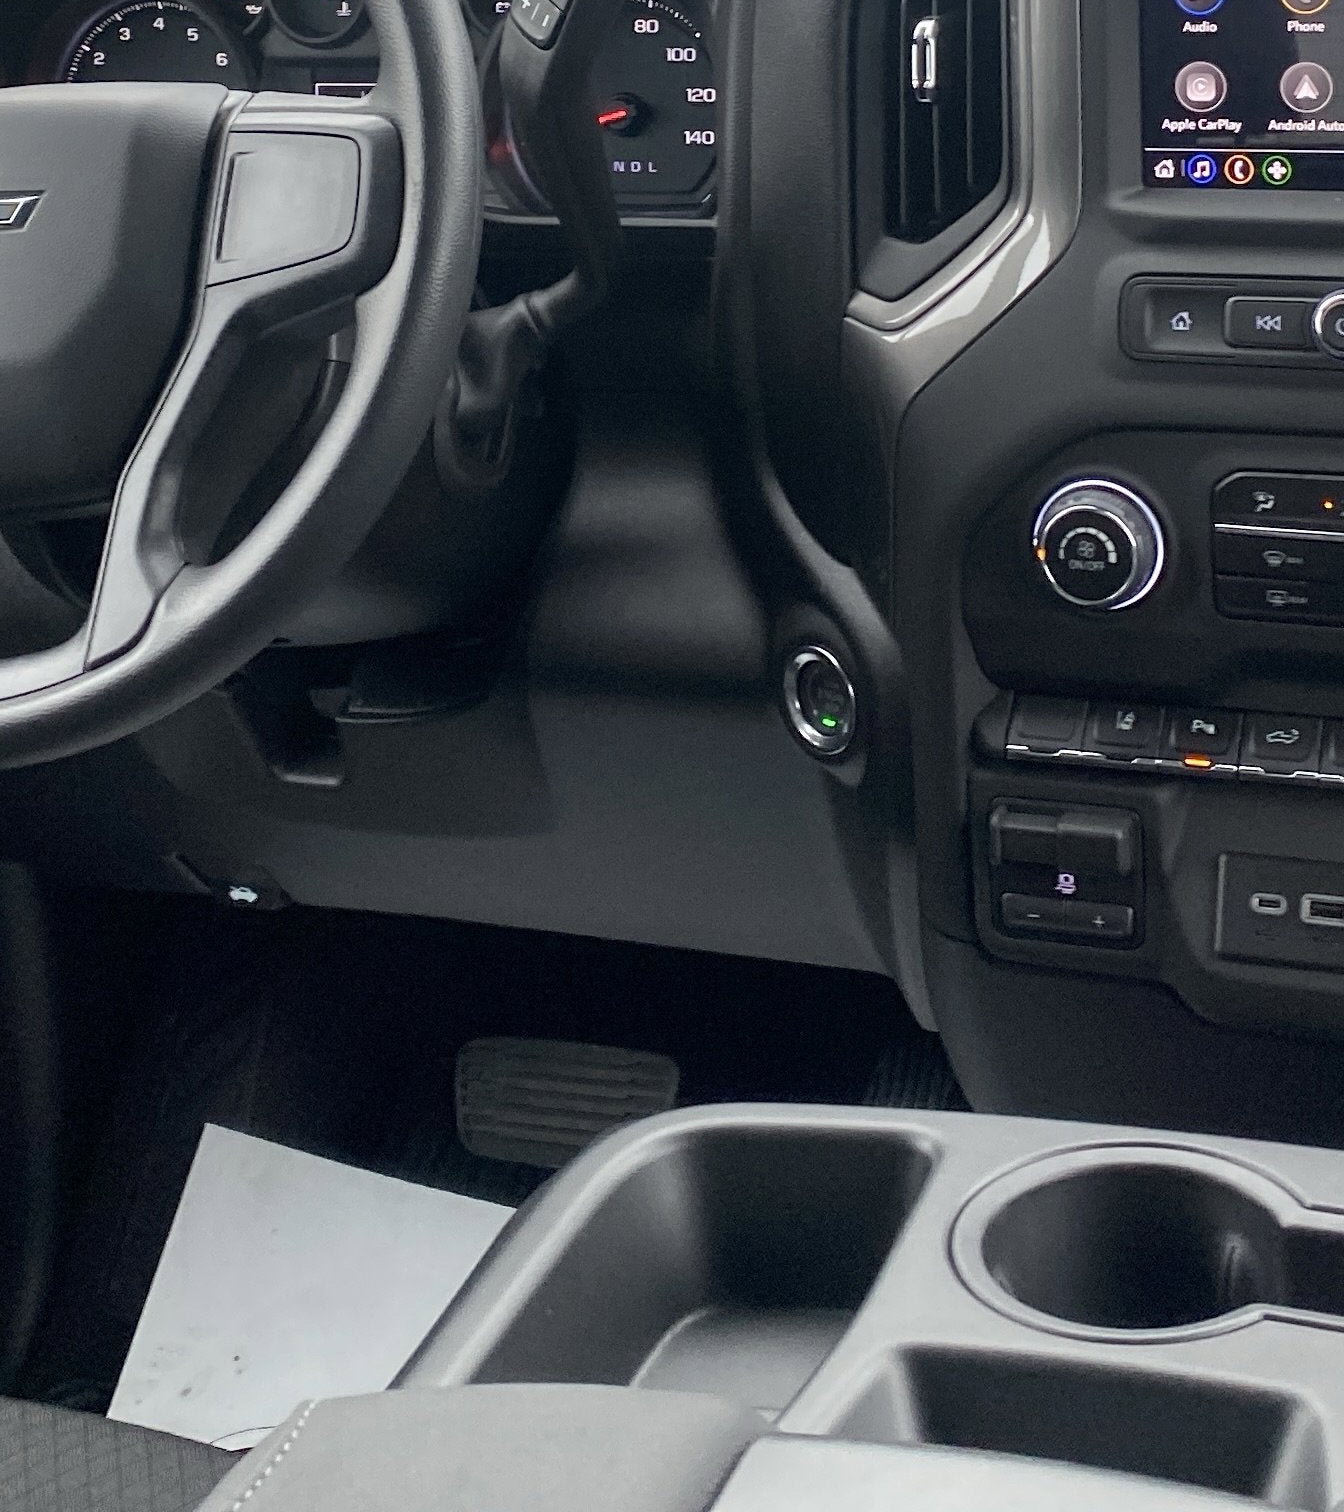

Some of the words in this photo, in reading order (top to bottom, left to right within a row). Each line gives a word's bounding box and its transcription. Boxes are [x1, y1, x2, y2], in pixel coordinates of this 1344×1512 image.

[153, 17, 165, 31] 4
[633, 18, 660, 34] 80
[1182, 20, 1218, 33] Audio
[1286, 20, 1326, 33] Phone
[119, 27, 131, 41] 3
[187, 27, 199, 42] 5
[93, 52, 105, 66] 2
[215, 52, 229, 67] 6
[665, 47, 697, 62] 100
[685, 87, 717, 103] 120
[1161, 119, 1197, 133] Apple
[1197, 118, 1243, 134] CarPlay
[1267, 119, 1316, 132] Android
[683, 130, 715, 145] 140
[613, 160, 625, 173] N
[648, 160, 658, 173] L
